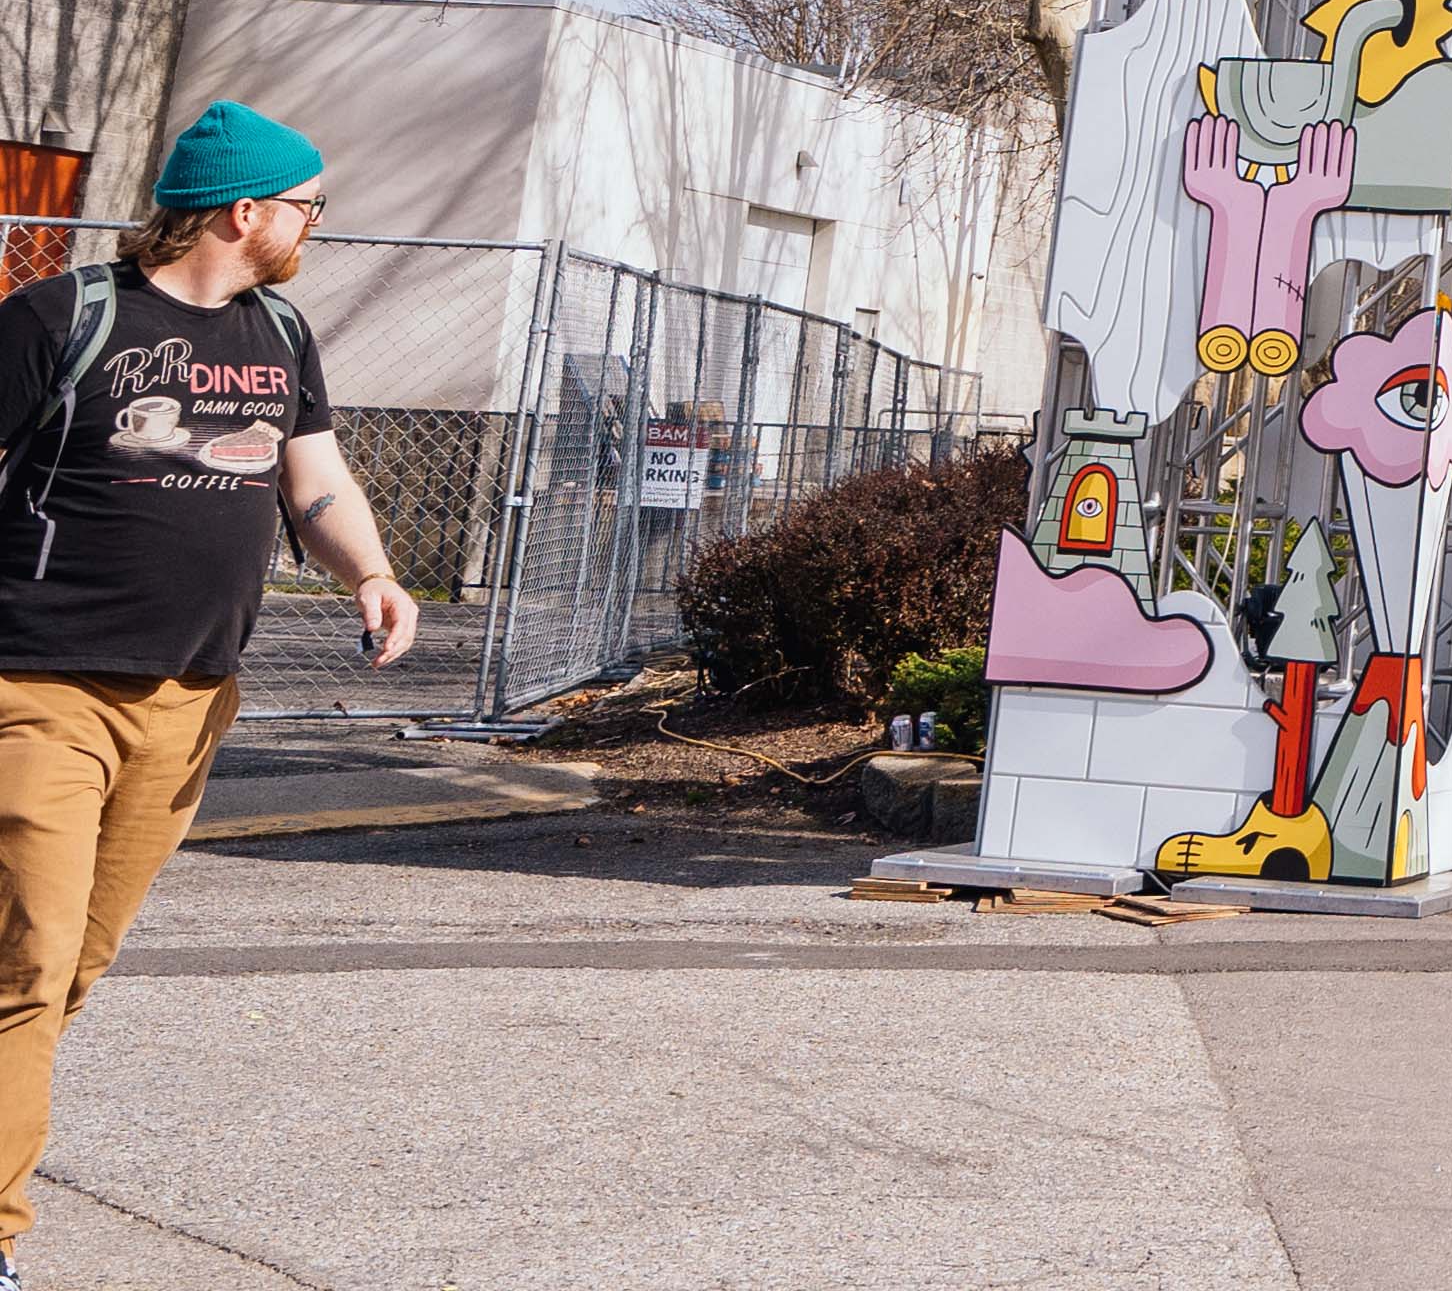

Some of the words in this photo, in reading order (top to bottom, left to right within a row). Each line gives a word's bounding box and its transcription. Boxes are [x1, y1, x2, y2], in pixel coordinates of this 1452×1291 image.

[190, 363, 290, 396] DINER
[192, 399, 239, 416] DAMN
[241, 401, 285, 418] GOOD
[648, 427, 689, 441] BAM
[650, 451, 677, 466] NO
[160, 473, 242, 491] COFFEE
[646, 468, 700, 484] RKING
